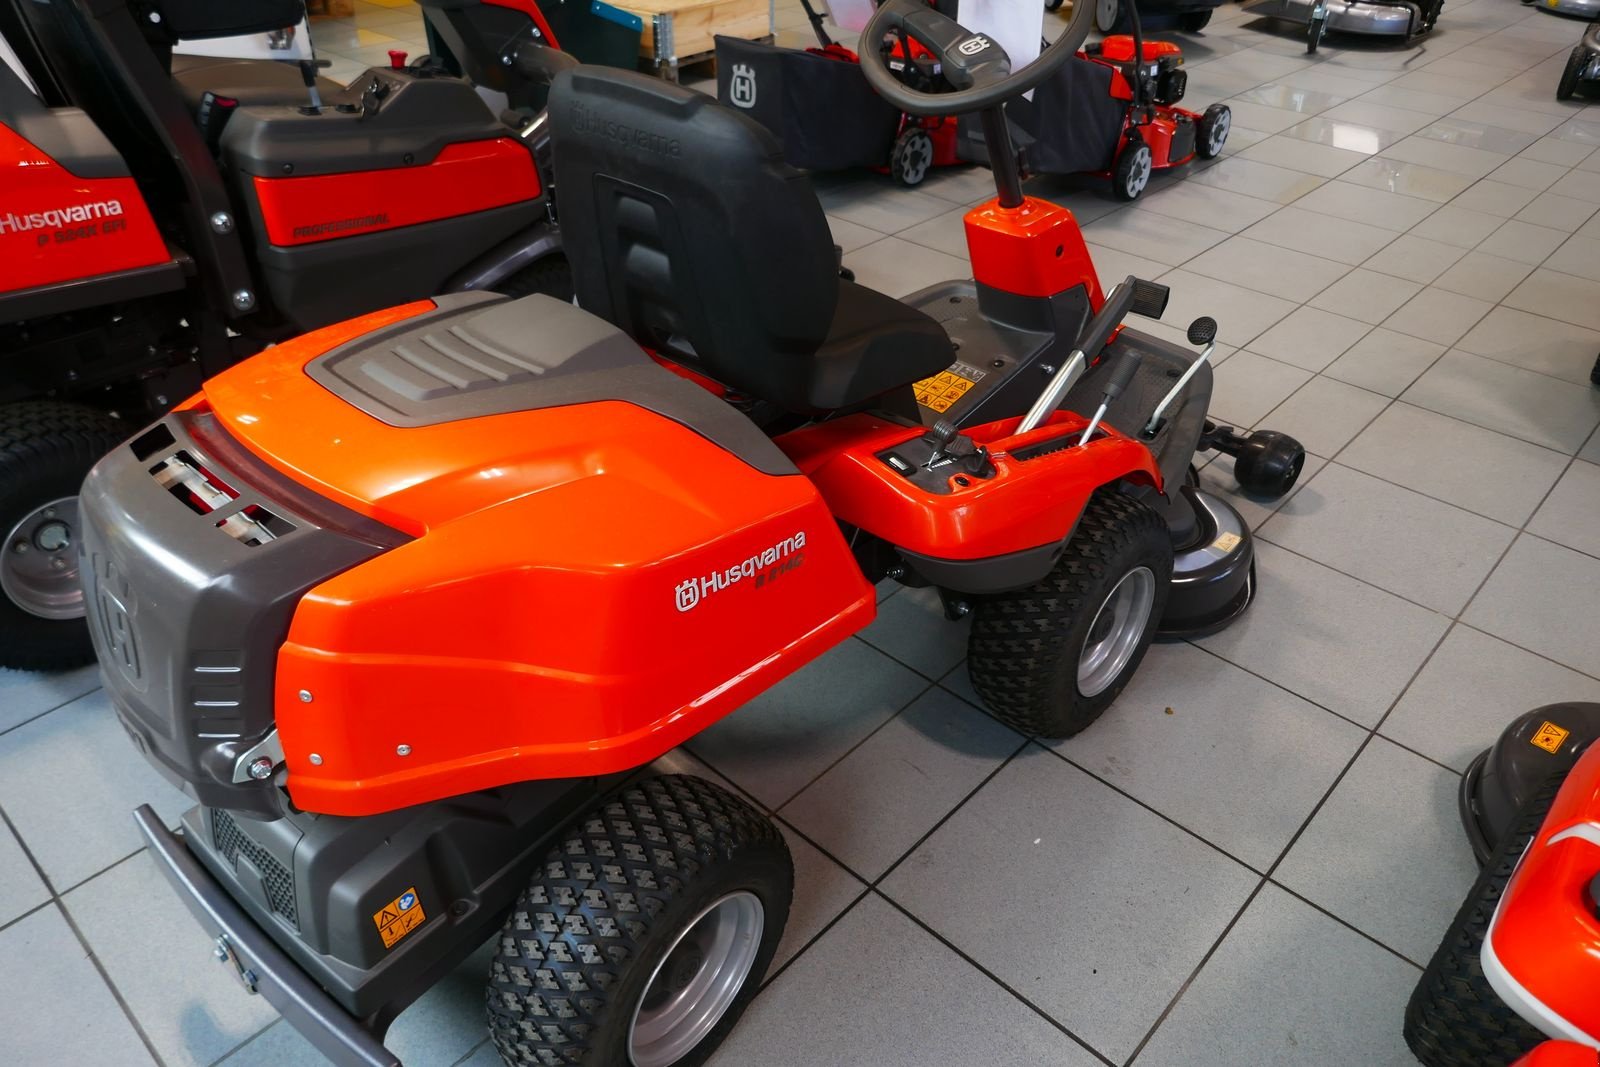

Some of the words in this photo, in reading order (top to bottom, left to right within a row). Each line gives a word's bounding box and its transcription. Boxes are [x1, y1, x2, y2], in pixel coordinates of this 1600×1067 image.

[0, 199, 123, 234] Husqvarna
[103, 219, 127, 234] EFI
[293, 212, 390, 238] PROFESSIONAL
[701, 531, 806, 598] Husqvarna
